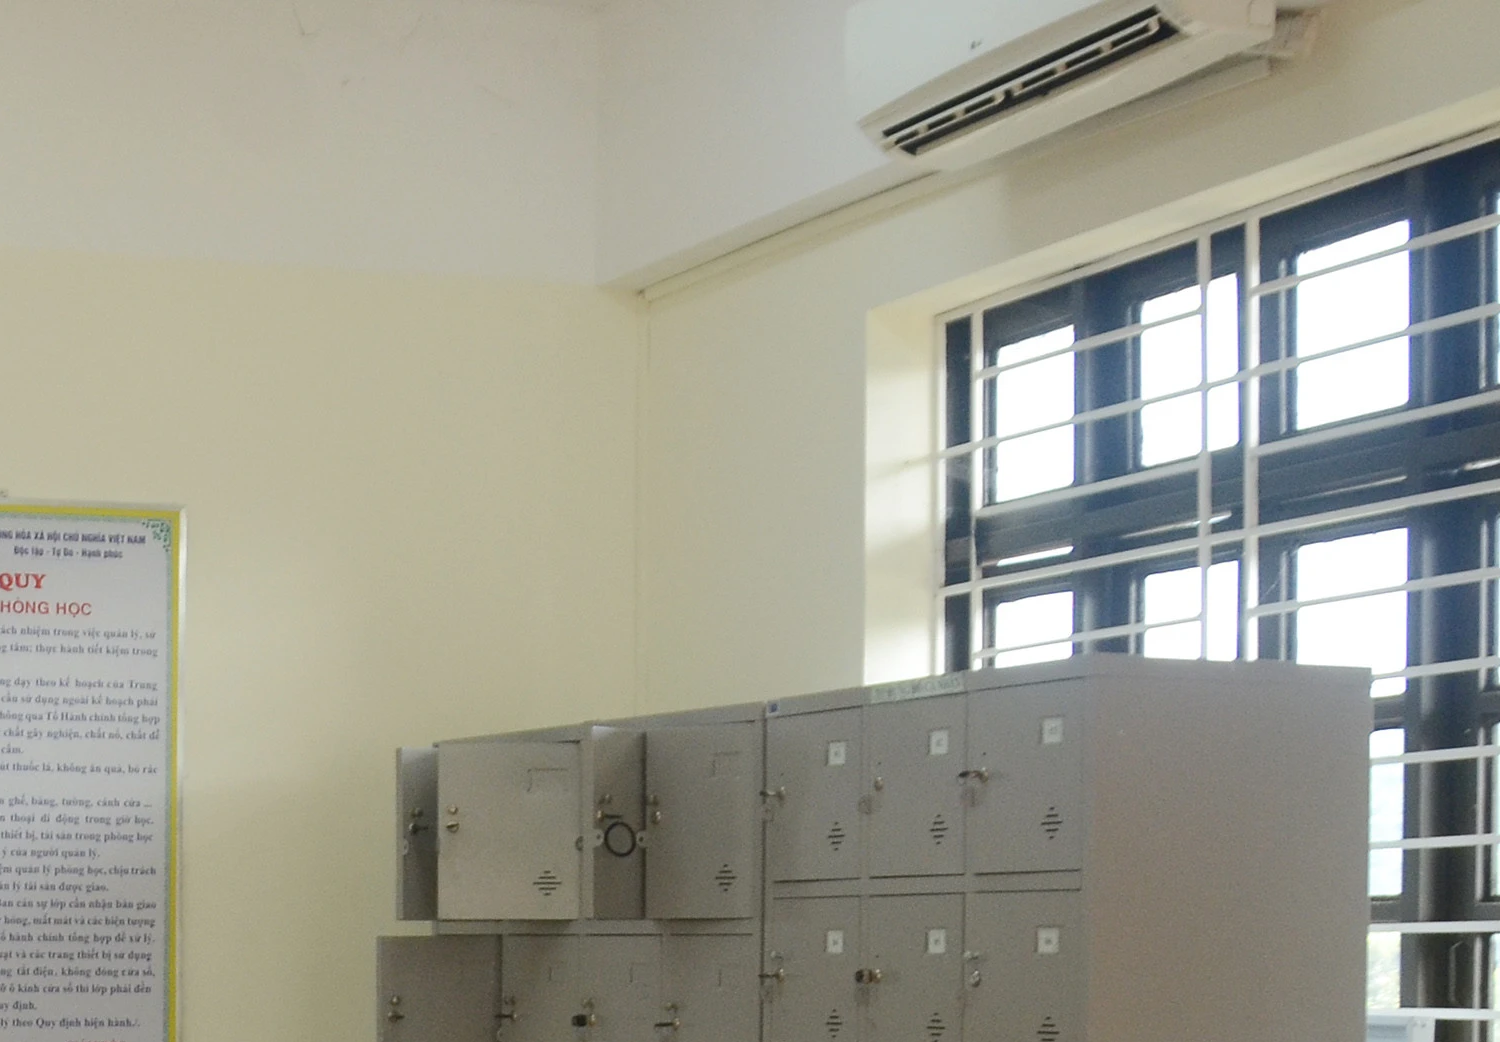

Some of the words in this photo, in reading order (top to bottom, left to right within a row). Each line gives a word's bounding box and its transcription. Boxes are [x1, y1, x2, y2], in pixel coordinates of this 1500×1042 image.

[56, 601, 92, 619] HỌC
[74, 832, 102, 843] trong
[136, 832, 153, 843] học
[108, 865, 130, 877] chịu
[58, 881, 83, 894] được
[36, 901, 48, 910] sự
[88, 899, 113, 911] nhận
[136, 900, 157, 911] giao
[105, 916, 126, 927] hiện
[127, 917, 156, 928] tượng
[93, 933, 112, 945] hợp
[48, 951, 75, 961] trang
[127, 950, 152, 962] dụng
[60, 966, 92, 978] không
[12, 1018, 34, 1027] theo
[35, 1017, 57, 1029] Quy
[59, 1018, 82, 1029] định
[84, 1017, 105, 1029] hiện
